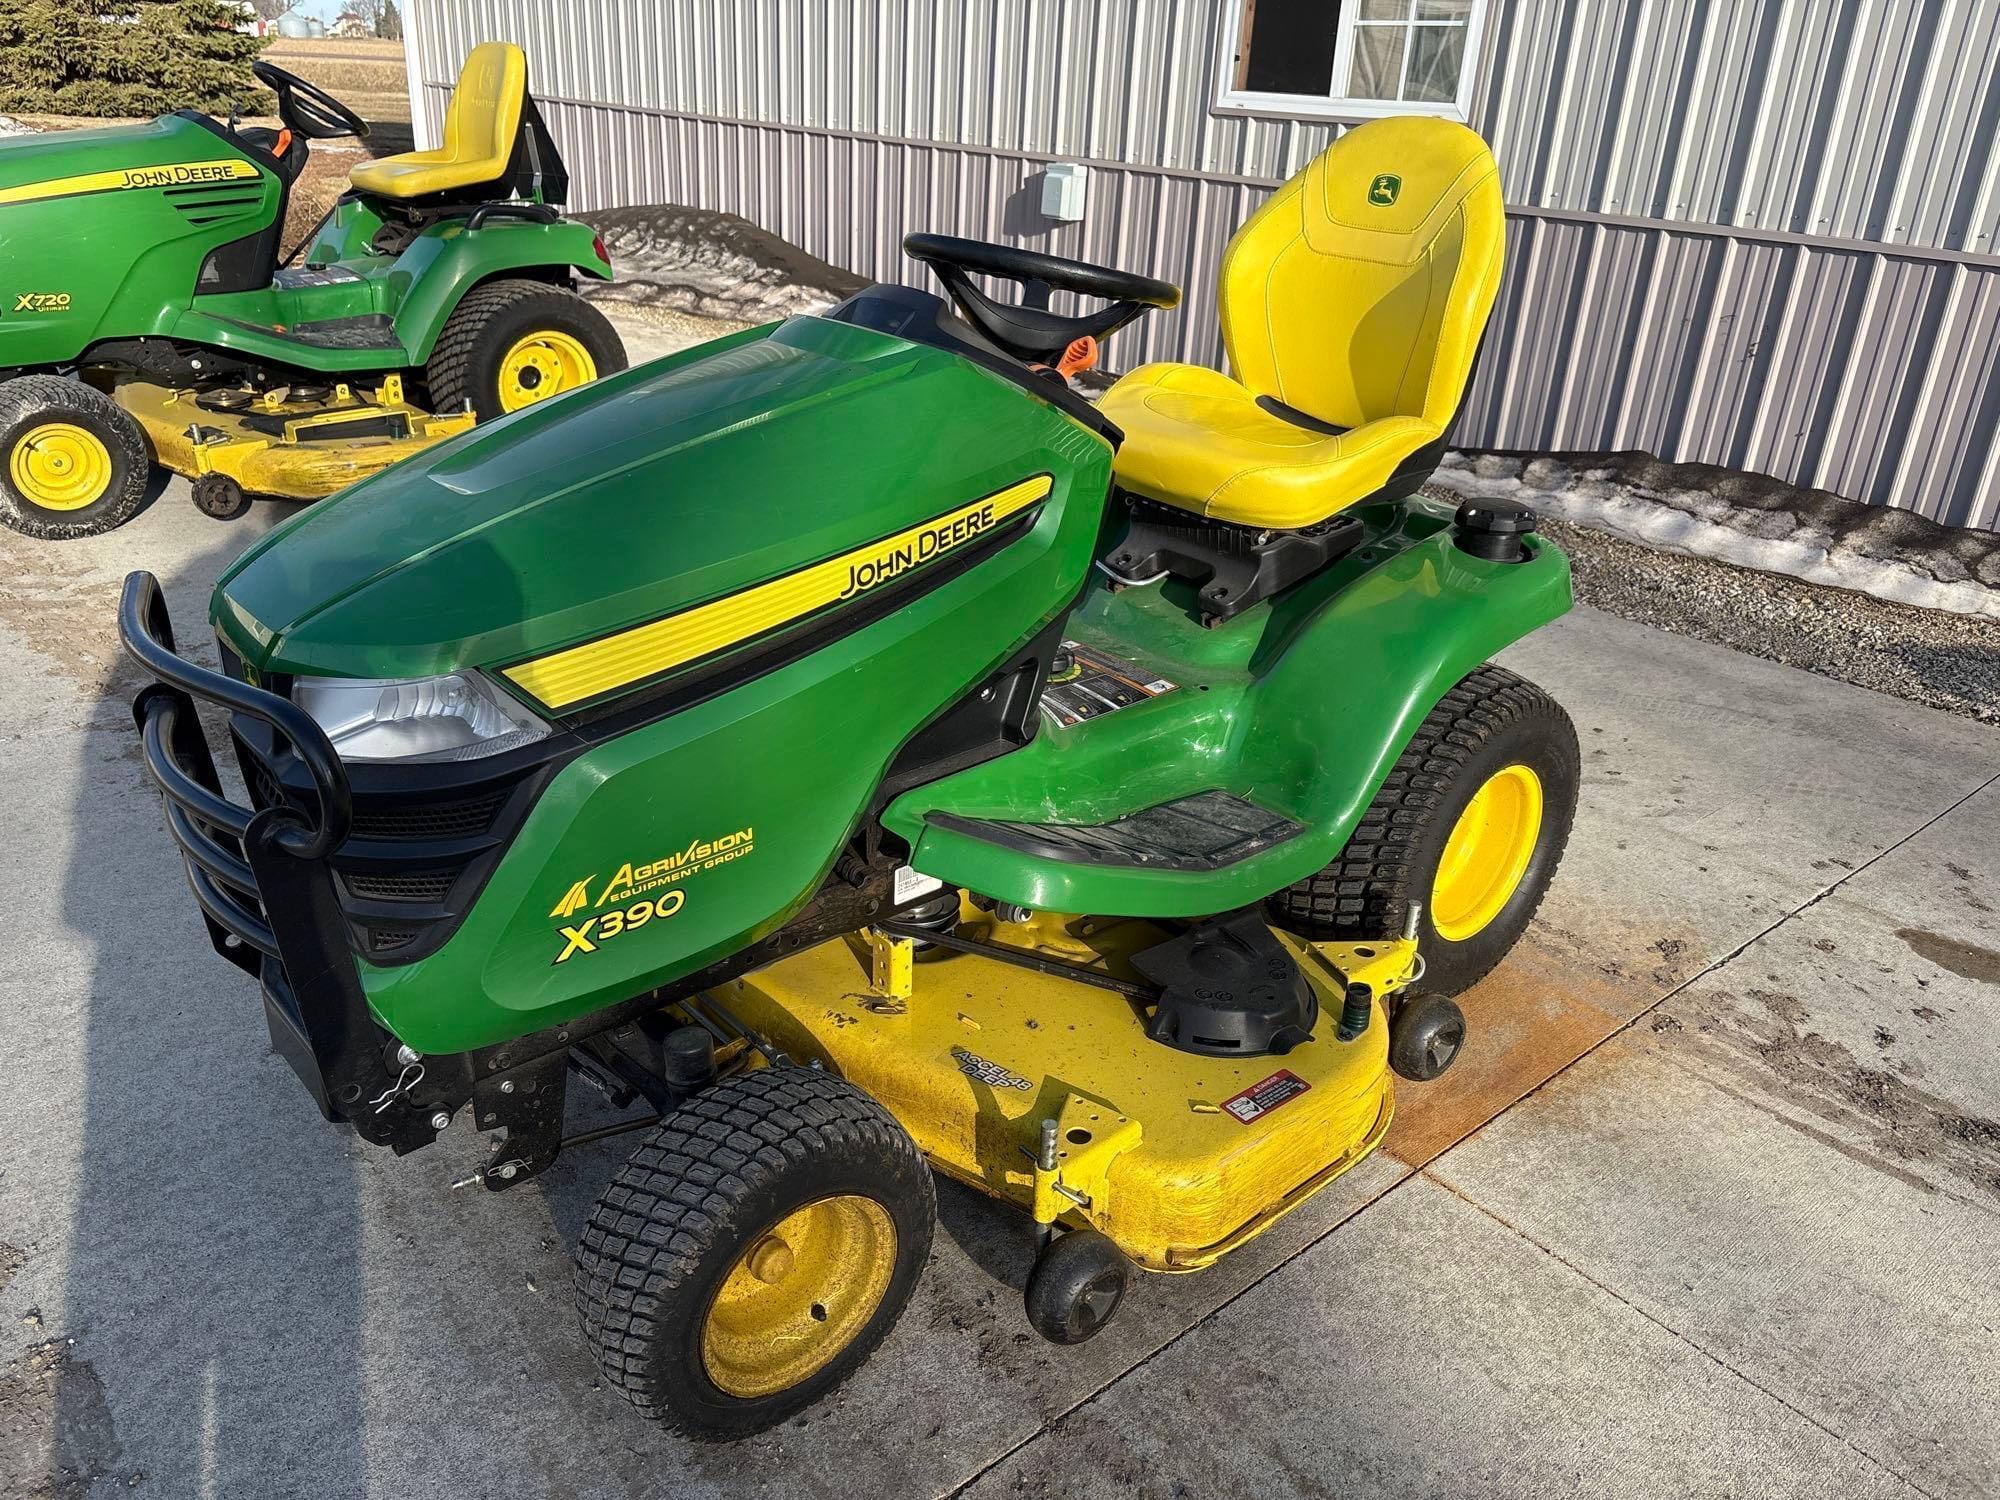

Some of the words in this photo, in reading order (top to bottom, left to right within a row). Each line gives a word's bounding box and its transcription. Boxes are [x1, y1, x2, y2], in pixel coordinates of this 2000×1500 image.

[121, 171, 173, 187] JOHN
[174, 166, 235, 181] DEERE
[13, 292, 71, 311] X720
[840, 543, 913, 598] JOHN
[917, 502, 995, 558] DEERE
[610, 865, 700, 903] EQUIPMENT
[704, 844, 754, 869] GROUP
[552, 888, 687, 965] X390
[952, 1051, 1010, 1080] ACCEL
[959, 1064, 1010, 1088] DEEP
[1007, 1078, 1033, 1091] 48
